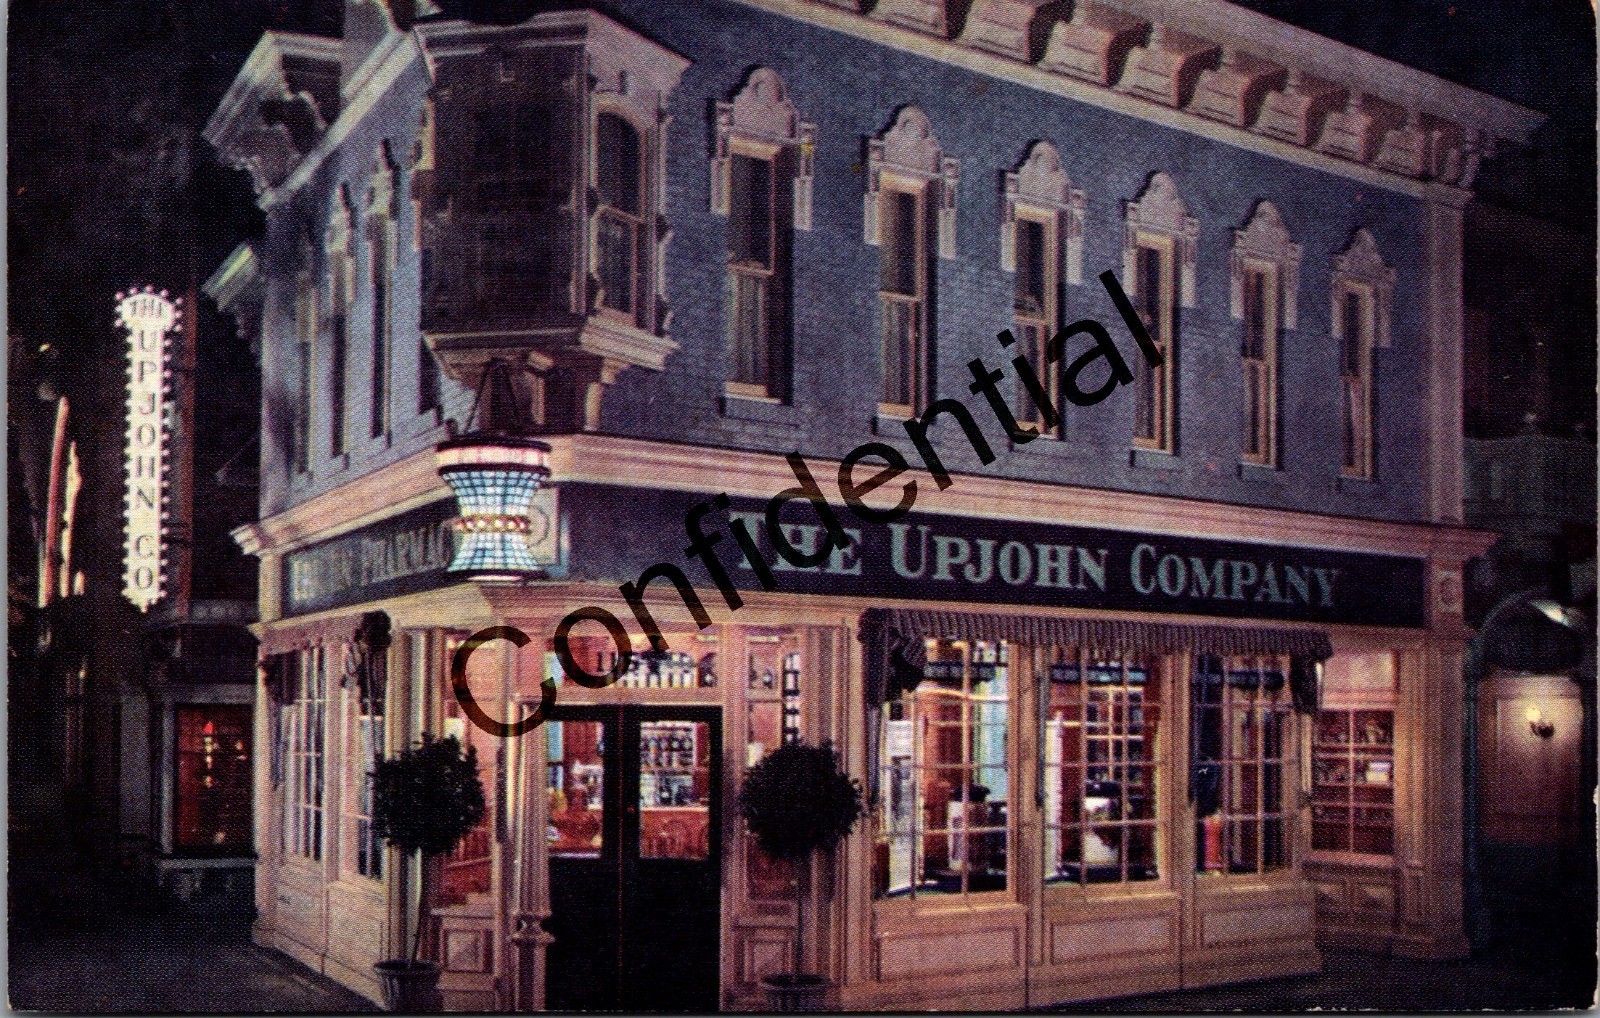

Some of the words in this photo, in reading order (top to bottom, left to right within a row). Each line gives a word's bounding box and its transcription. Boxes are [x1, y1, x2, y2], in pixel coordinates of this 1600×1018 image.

[134, 329, 158, 510] UPJOHN
[134, 534, 155, 590] CO
[360, 520, 453, 588] PHARMAC
[729, 511, 862, 576] THE
[889, 523, 1108, 592] UPJOHN
[1129, 543, 1341, 608] COMPANY
